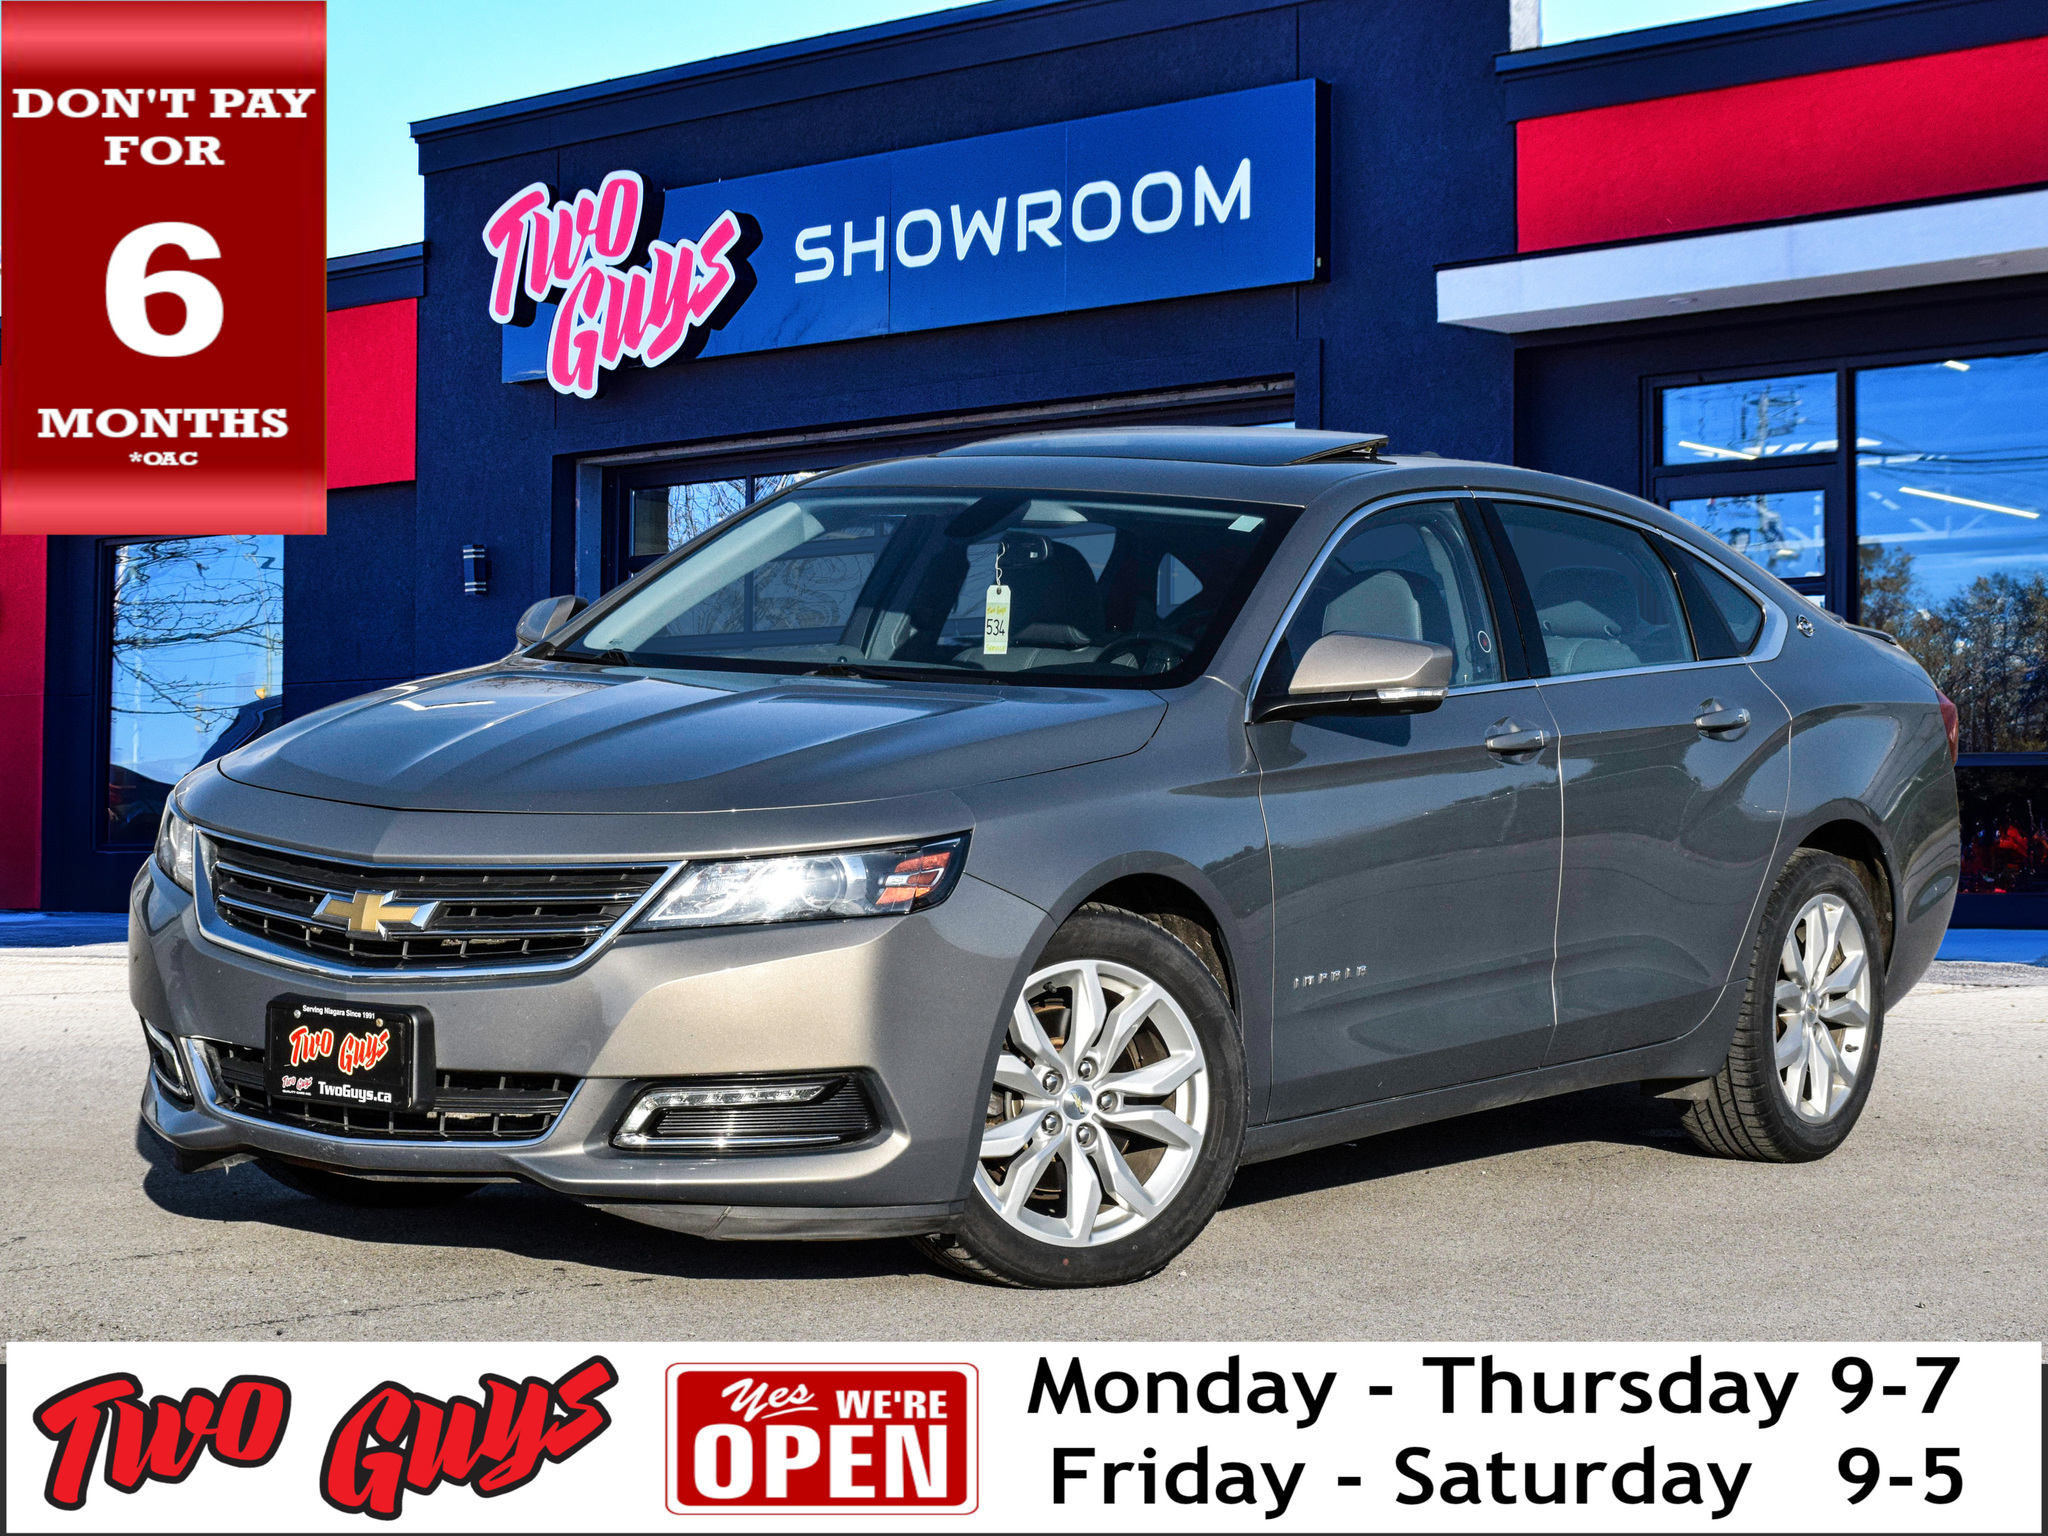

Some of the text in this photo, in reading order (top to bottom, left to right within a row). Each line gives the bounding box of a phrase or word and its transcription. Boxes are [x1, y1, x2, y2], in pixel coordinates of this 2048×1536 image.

[795, 158, 1251, 283] SHOWROOM
[986, 619, 1005, 636] 534
[302, 1004, 375, 1019] Serving Niagara Since 1991
[318, 1081, 392, 1103] TwoGuys.ca
